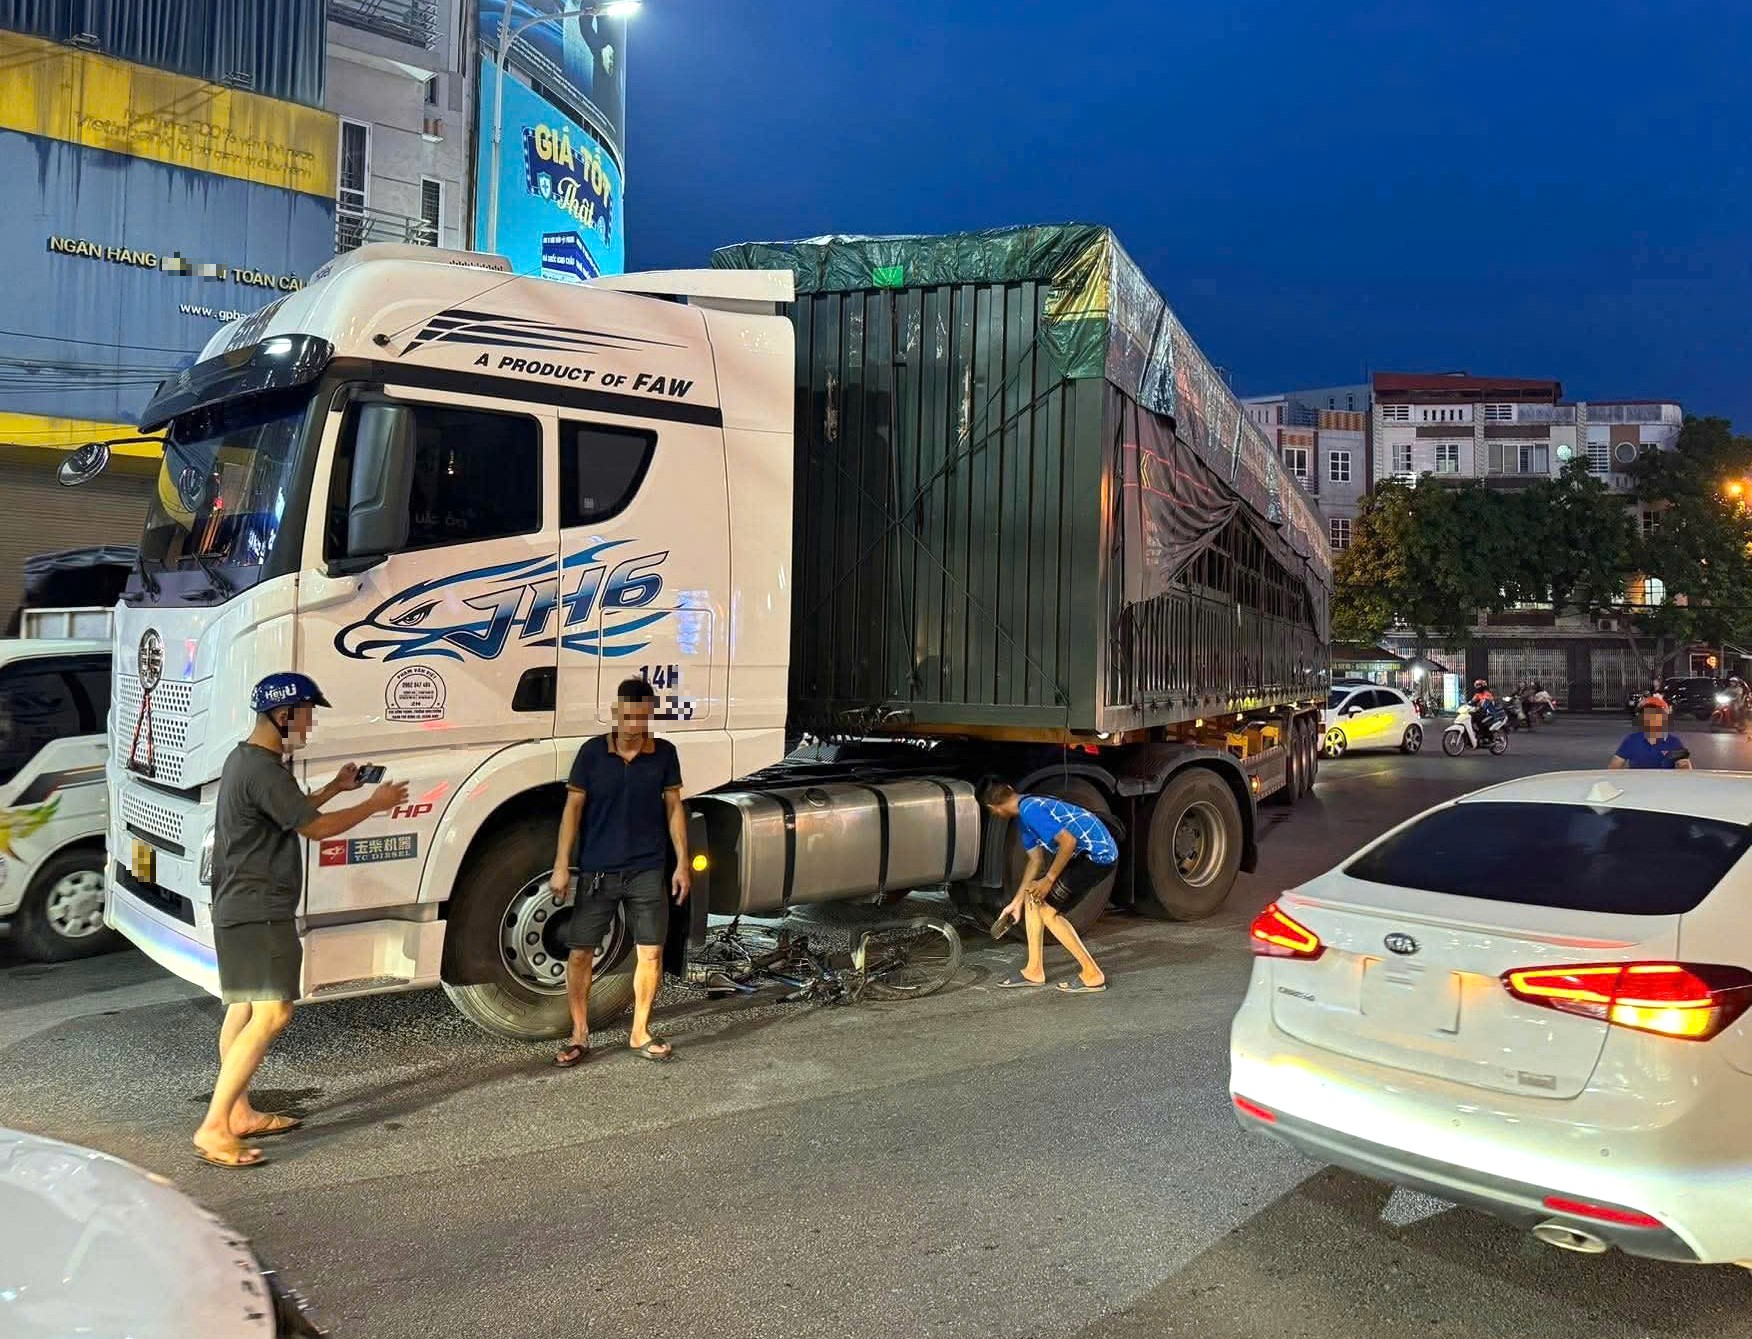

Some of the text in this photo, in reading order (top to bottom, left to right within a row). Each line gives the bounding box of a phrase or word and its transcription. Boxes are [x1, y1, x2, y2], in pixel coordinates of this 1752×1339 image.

[535, 124, 611, 208] GIÁ TỐT
[49, 236, 102, 258] NGÂN
[107, 242, 157, 267] HÀNG
[233, 267, 276, 289] TOÀN
[475, 353, 694, 397] A PRODUCT OF FAW
[443, 551, 669, 659] JH6
[265, 683, 297, 700] HeyU
[391, 803, 433, 819] HP
[354, 850, 411, 862] YC DIESEL
